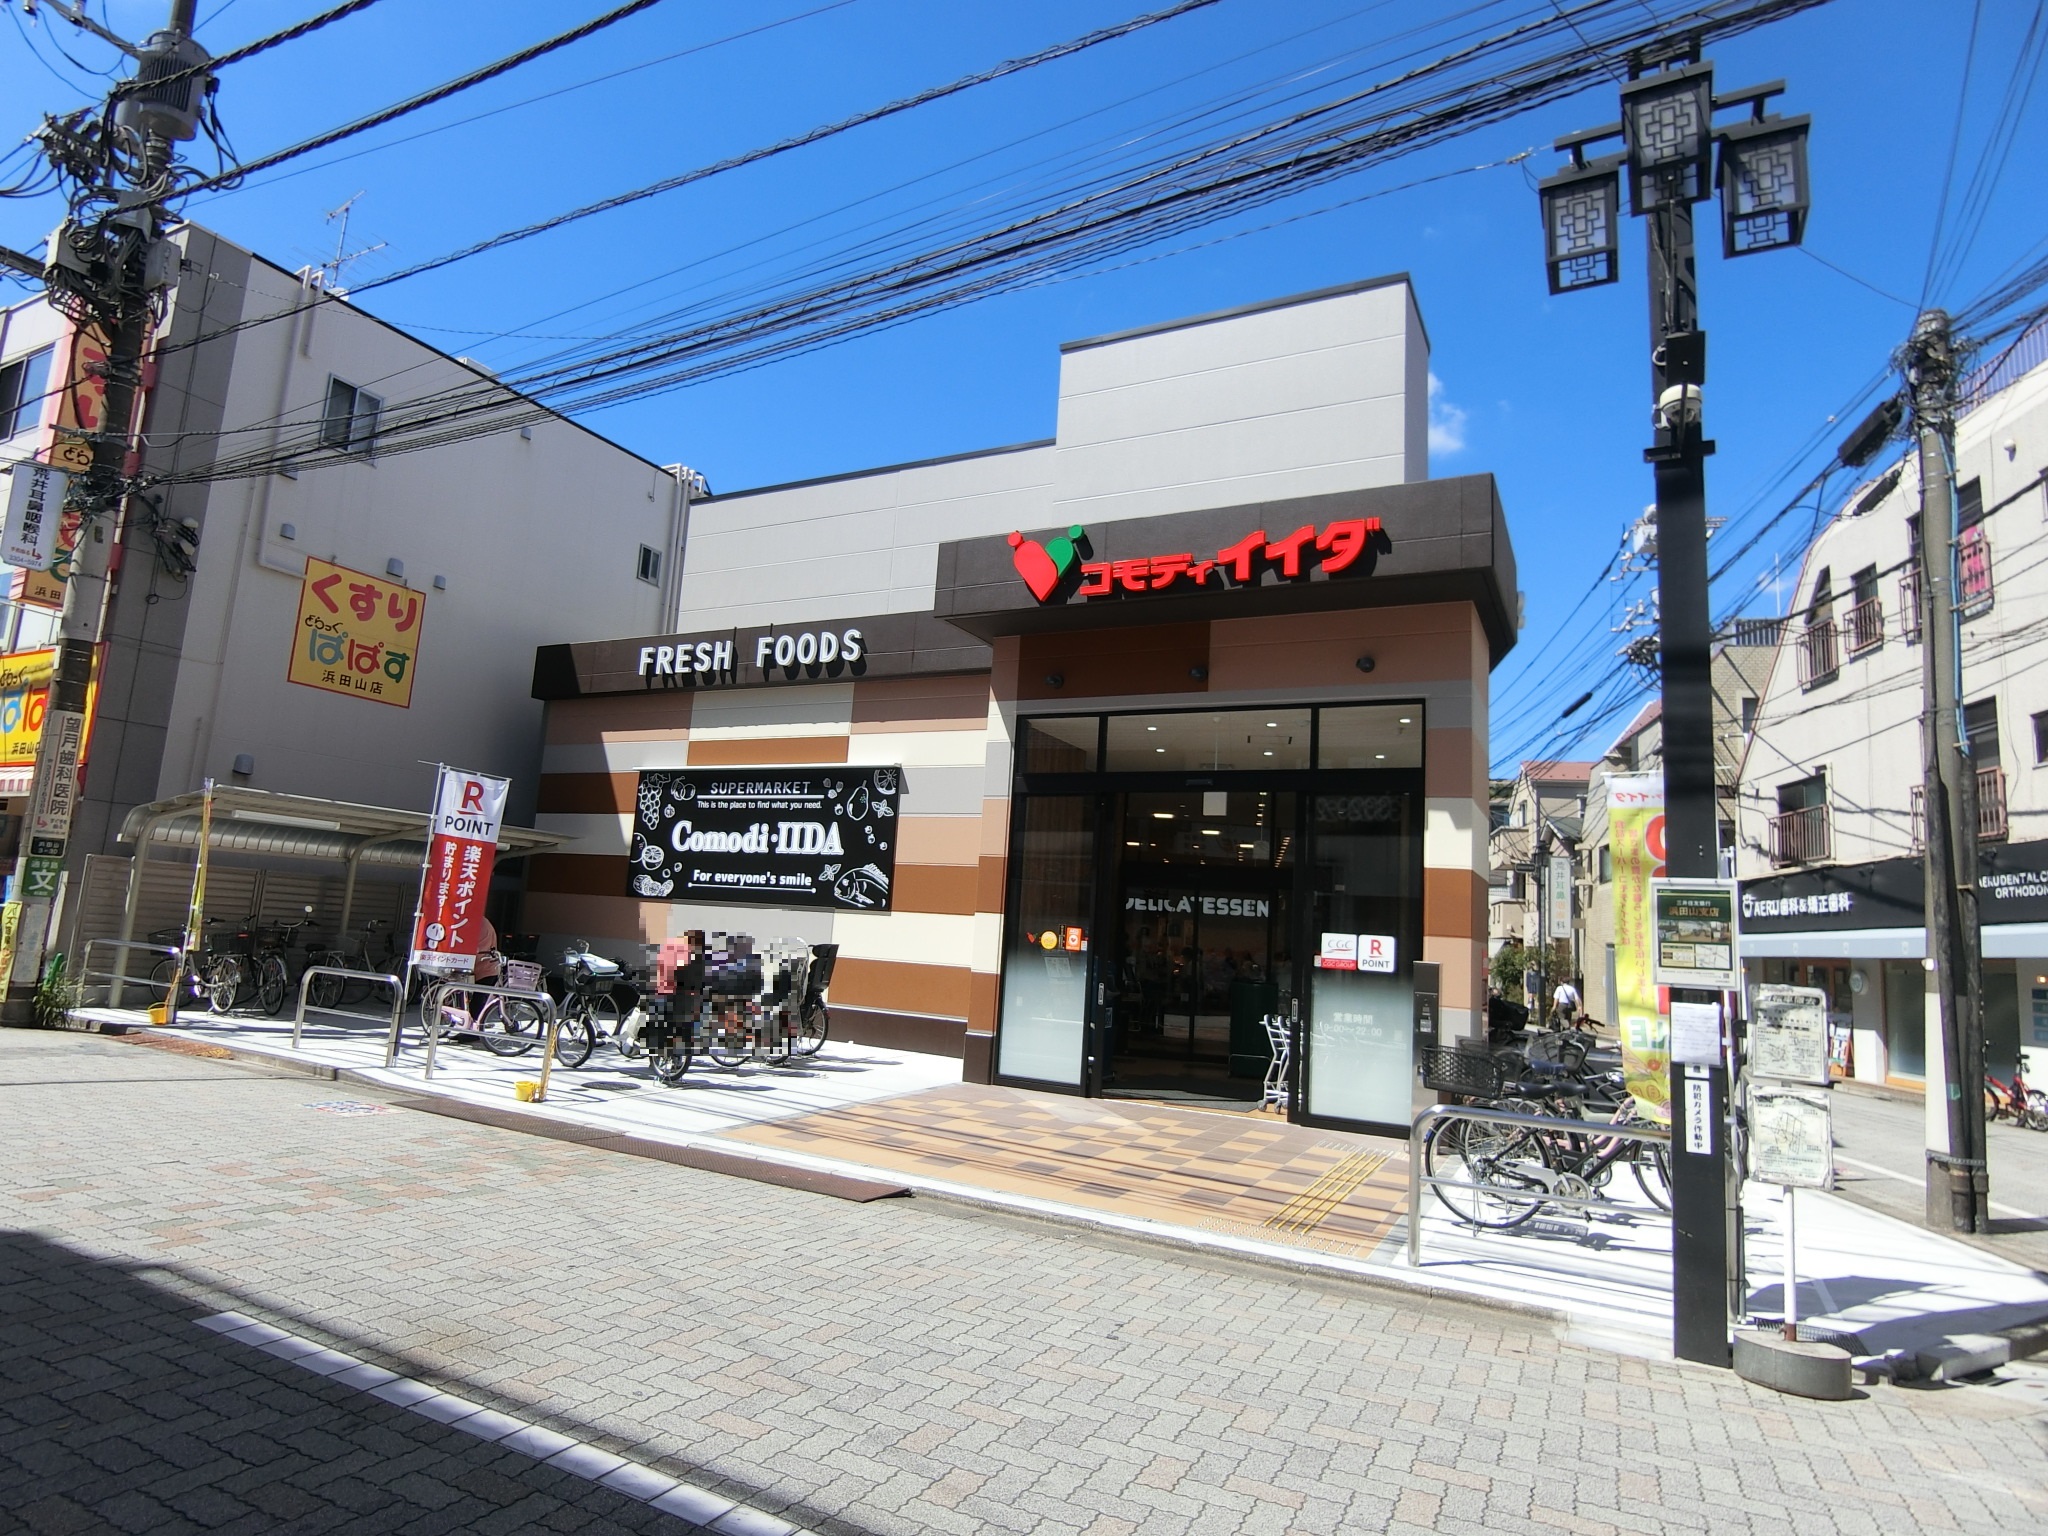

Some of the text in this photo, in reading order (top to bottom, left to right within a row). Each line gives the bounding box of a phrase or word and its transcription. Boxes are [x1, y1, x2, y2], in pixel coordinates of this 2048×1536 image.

[20, 467, 50, 547] 荒井耳鼻咽喉科
[1079, 516, 1382, 596] コモディイイダ
[311, 573, 417, 632] くすり
[304, 614, 344, 634] どらっく
[309, 629, 410, 683] ぱぱす
[639, 628, 863, 676] FRESH FOODS
[321, 669, 384, 695] 浜田山店
[49, 716, 82, 816] 望月歯科医院
[461, 780, 485, 812] R
[710, 781, 811, 795] SUPERMARKET
[697, 800, 823, 811] This is the place to find what you need.
[445, 815, 494, 836] POINT
[28, 869, 56, 891] 文
[693, 869, 812, 886] For everyone's smile
[450, 845, 482, 948] 楽天ポイント
[1668, 906, 1720, 918] 浜田山支店
[1327, 939, 1354, 949] CGC
[1370, 939, 1382, 956] R
[421, 954, 469, 964] 楽天ポイントカード
[1361, 959, 1391, 969] POINT
[1333, 1012, 1374, 1025] 営業時間
[1692, 1083, 1703, 1150] 防犯カメラ作動中
